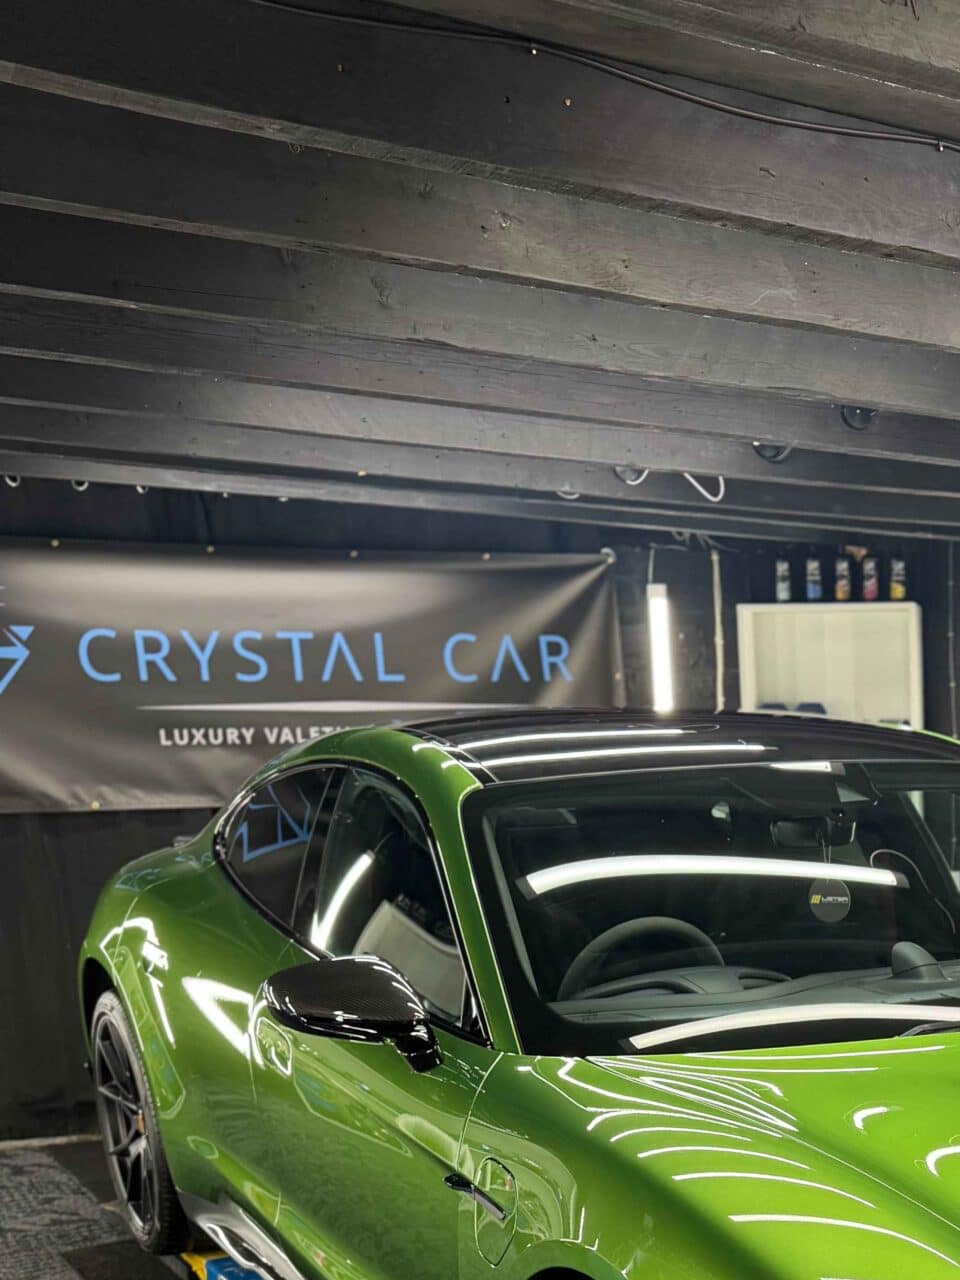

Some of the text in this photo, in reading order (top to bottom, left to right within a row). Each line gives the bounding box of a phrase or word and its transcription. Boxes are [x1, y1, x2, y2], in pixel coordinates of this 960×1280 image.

[78, 628, 573, 683] CRYSTAL CAR
[159, 727, 255, 746] LUXURY
